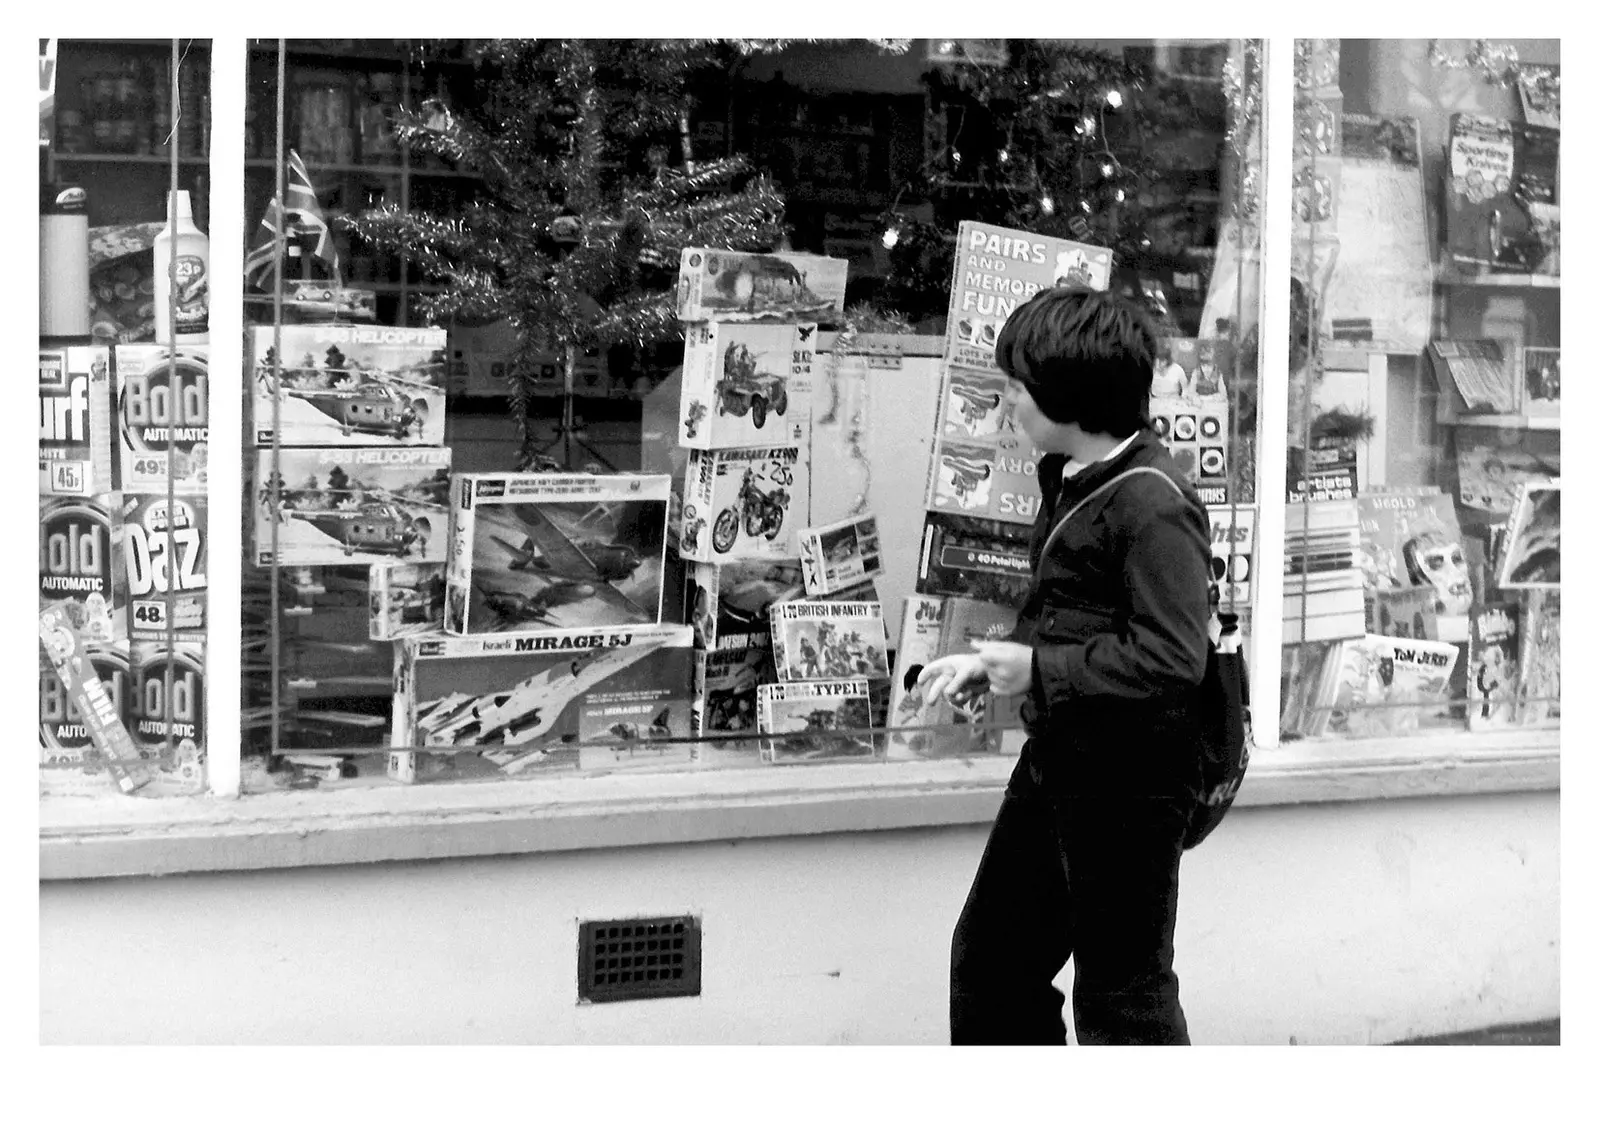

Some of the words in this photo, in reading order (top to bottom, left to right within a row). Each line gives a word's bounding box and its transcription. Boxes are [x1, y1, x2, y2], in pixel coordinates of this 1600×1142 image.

[968, 229, 1047, 265] PAIRS
[967, 254, 1006, 272] AND
[961, 290, 1017, 319] FUN
[352, 331, 446, 345] HELICOPTER
[39, 375, 88, 441] urf
[125, 374, 208, 427] Bold
[143, 427, 208, 443] AUTMATIC
[355, 451, 451, 465] HELICOPTER
[995, 455, 1036, 476] ORY
[39, 523, 101, 576] old
[124, 523, 207, 596] Daz
[42, 576, 103, 592] AUTOMATIC
[798, 605, 828, 617] BRITISH
[830, 604, 868, 617] INFANTRY
[515, 634, 605, 652] MIRAGE
[608, 633, 633, 647] 5J
[1394, 648, 1416, 662] TOM
[1418, 651, 1448, 667] JERRY
